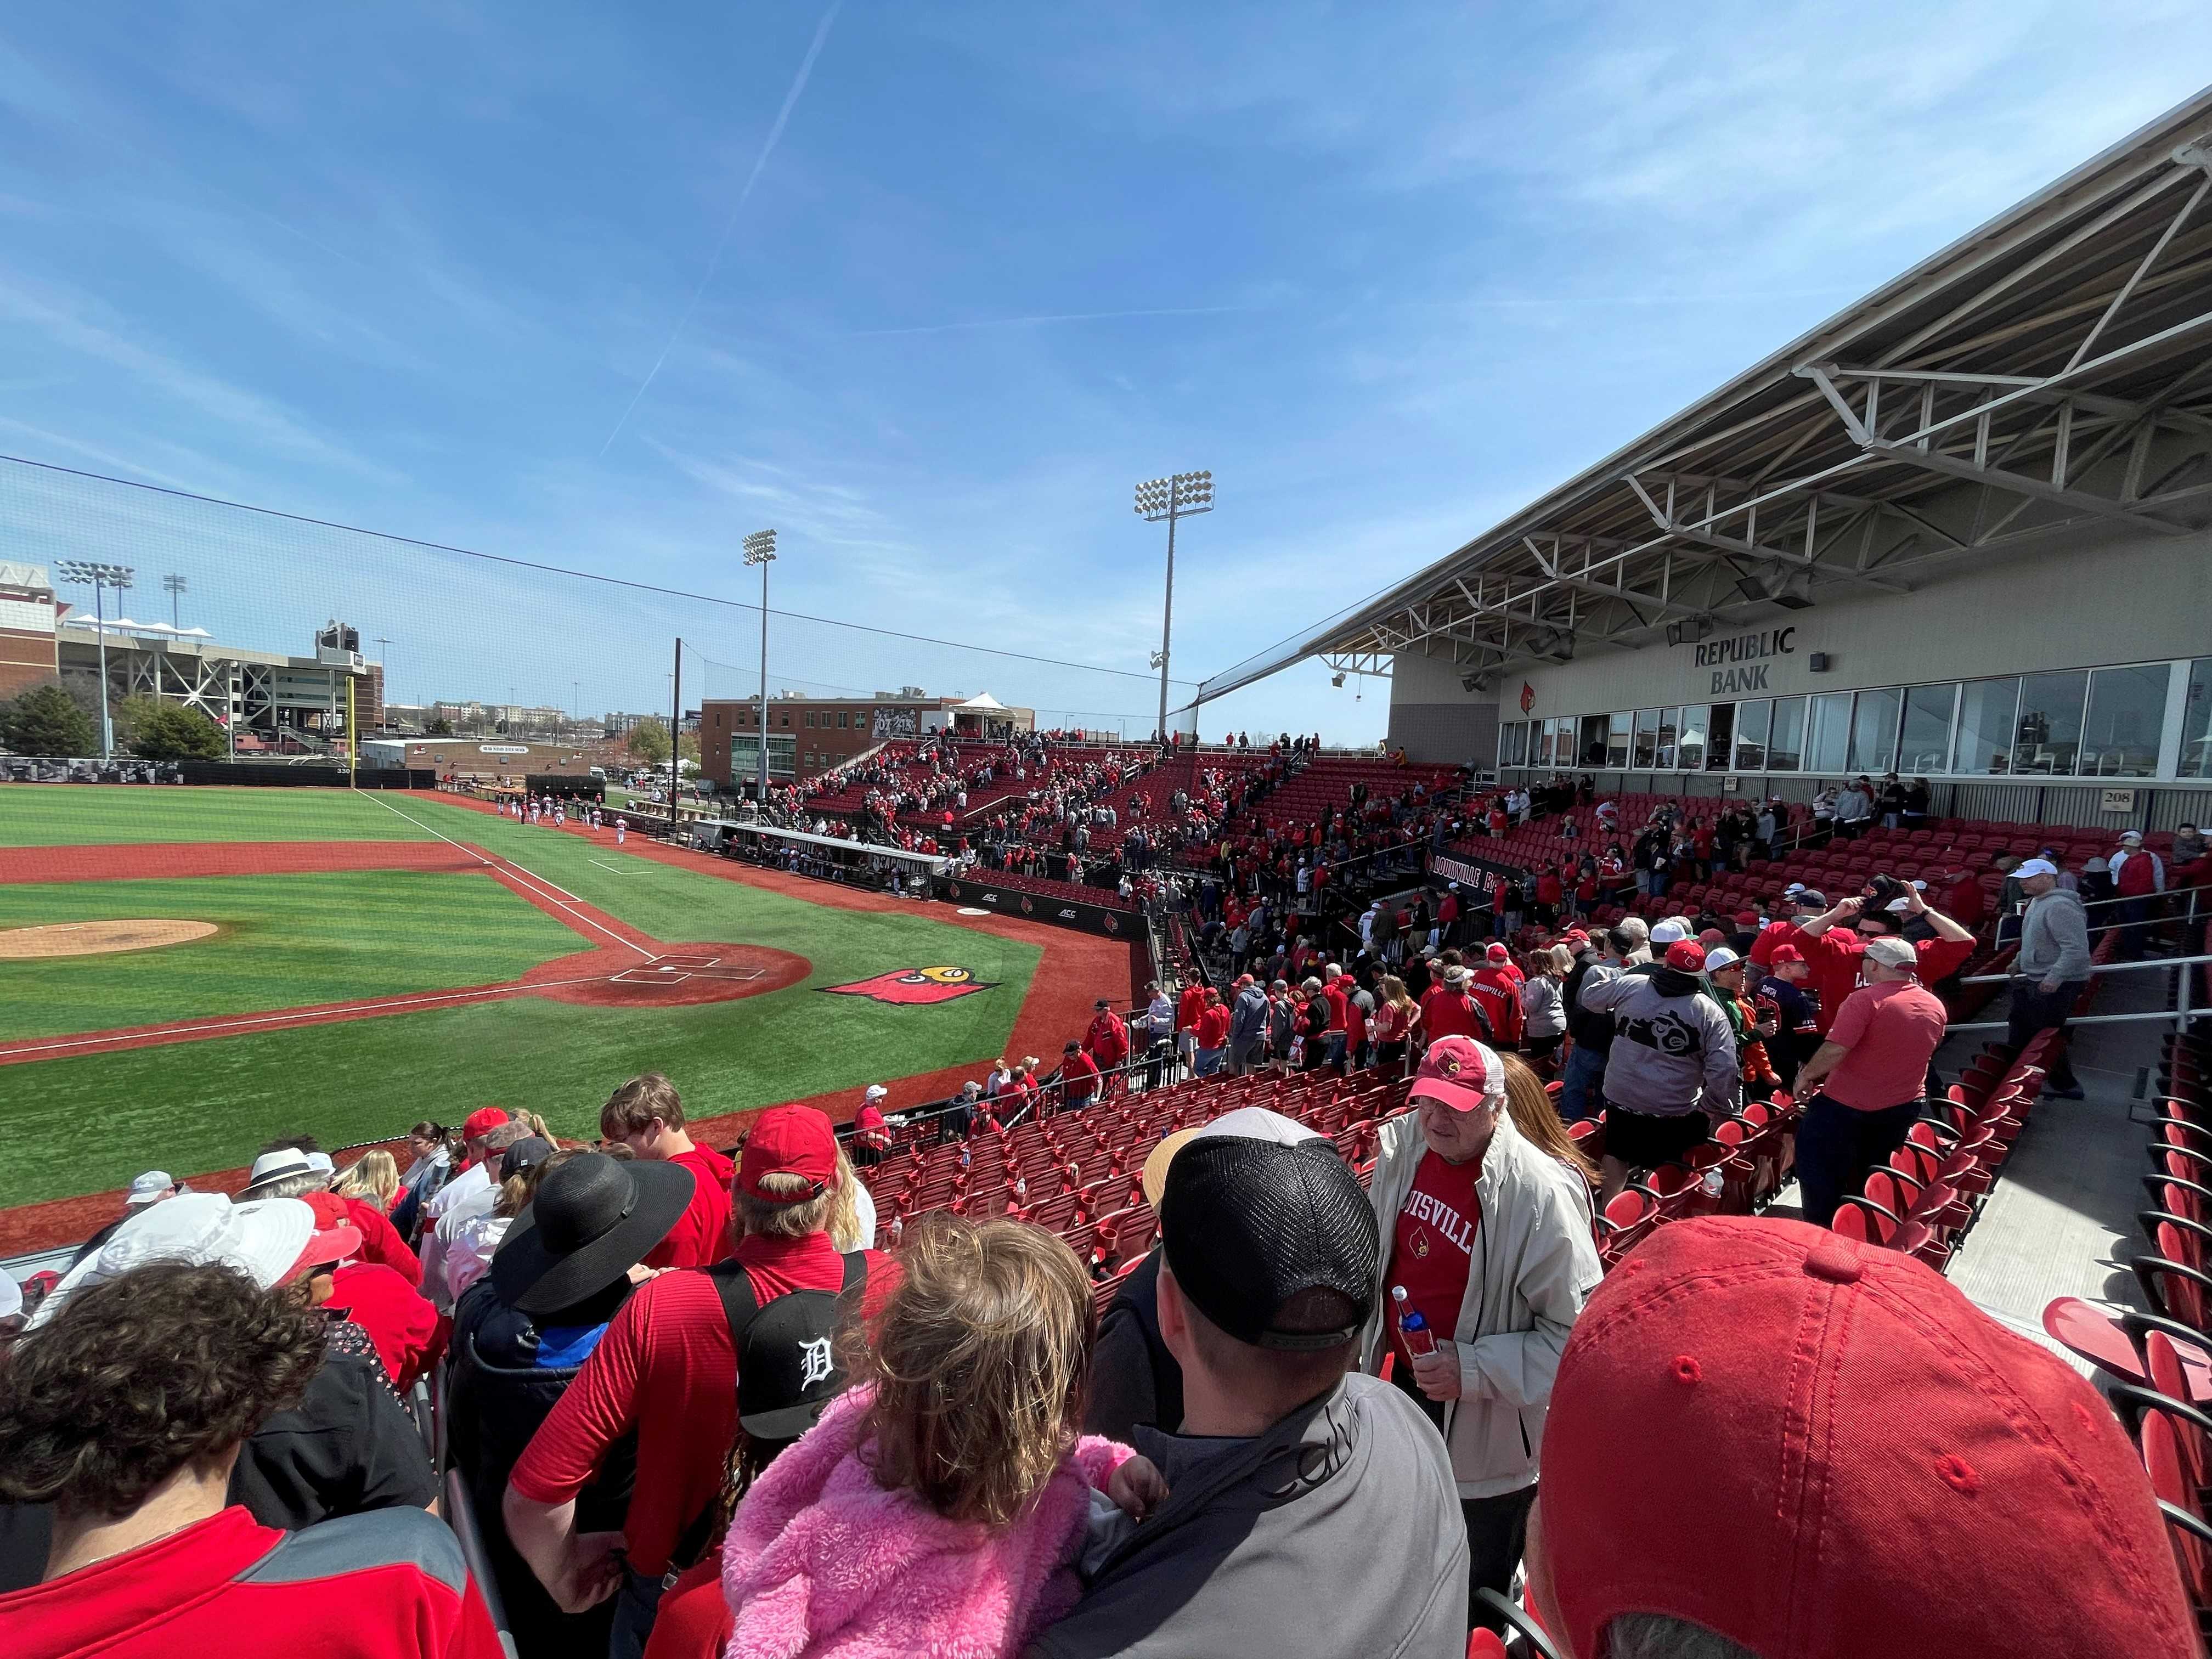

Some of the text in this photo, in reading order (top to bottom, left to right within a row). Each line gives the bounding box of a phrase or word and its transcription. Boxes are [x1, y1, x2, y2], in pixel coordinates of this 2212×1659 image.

[1695, 627, 1796, 668] REPUBLIC
[1710, 663, 1770, 695] BANK
[2104, 792, 2130, 803] 208
[1433, 855, 1481, 888] LOUISVILLE
[981, 893, 998, 902] ACC
[1058, 909, 1077, 918] ACC
[1472, 982, 1506, 998] LOUISVILLE
[798, 1336, 834, 1392] D
